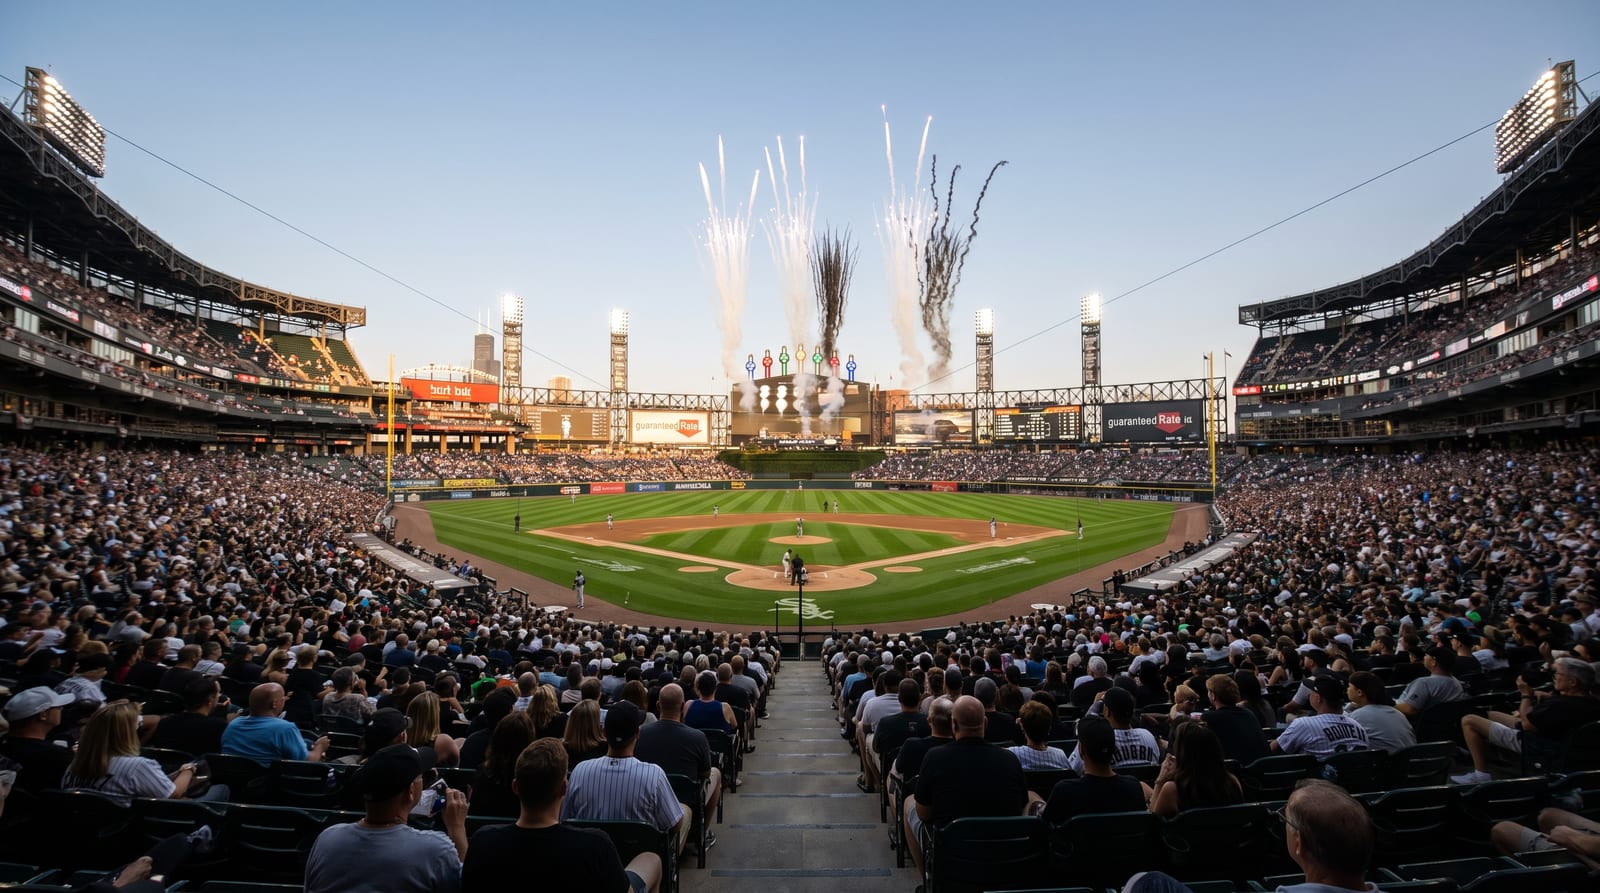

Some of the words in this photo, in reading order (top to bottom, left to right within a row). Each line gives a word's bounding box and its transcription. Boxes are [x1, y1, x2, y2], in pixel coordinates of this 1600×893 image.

[635, 422, 679, 431] guaranteed
[680, 421, 698, 430] Rate
[1108, 415, 1157, 428] guaranteed
[1158, 415, 1181, 424] Rate
